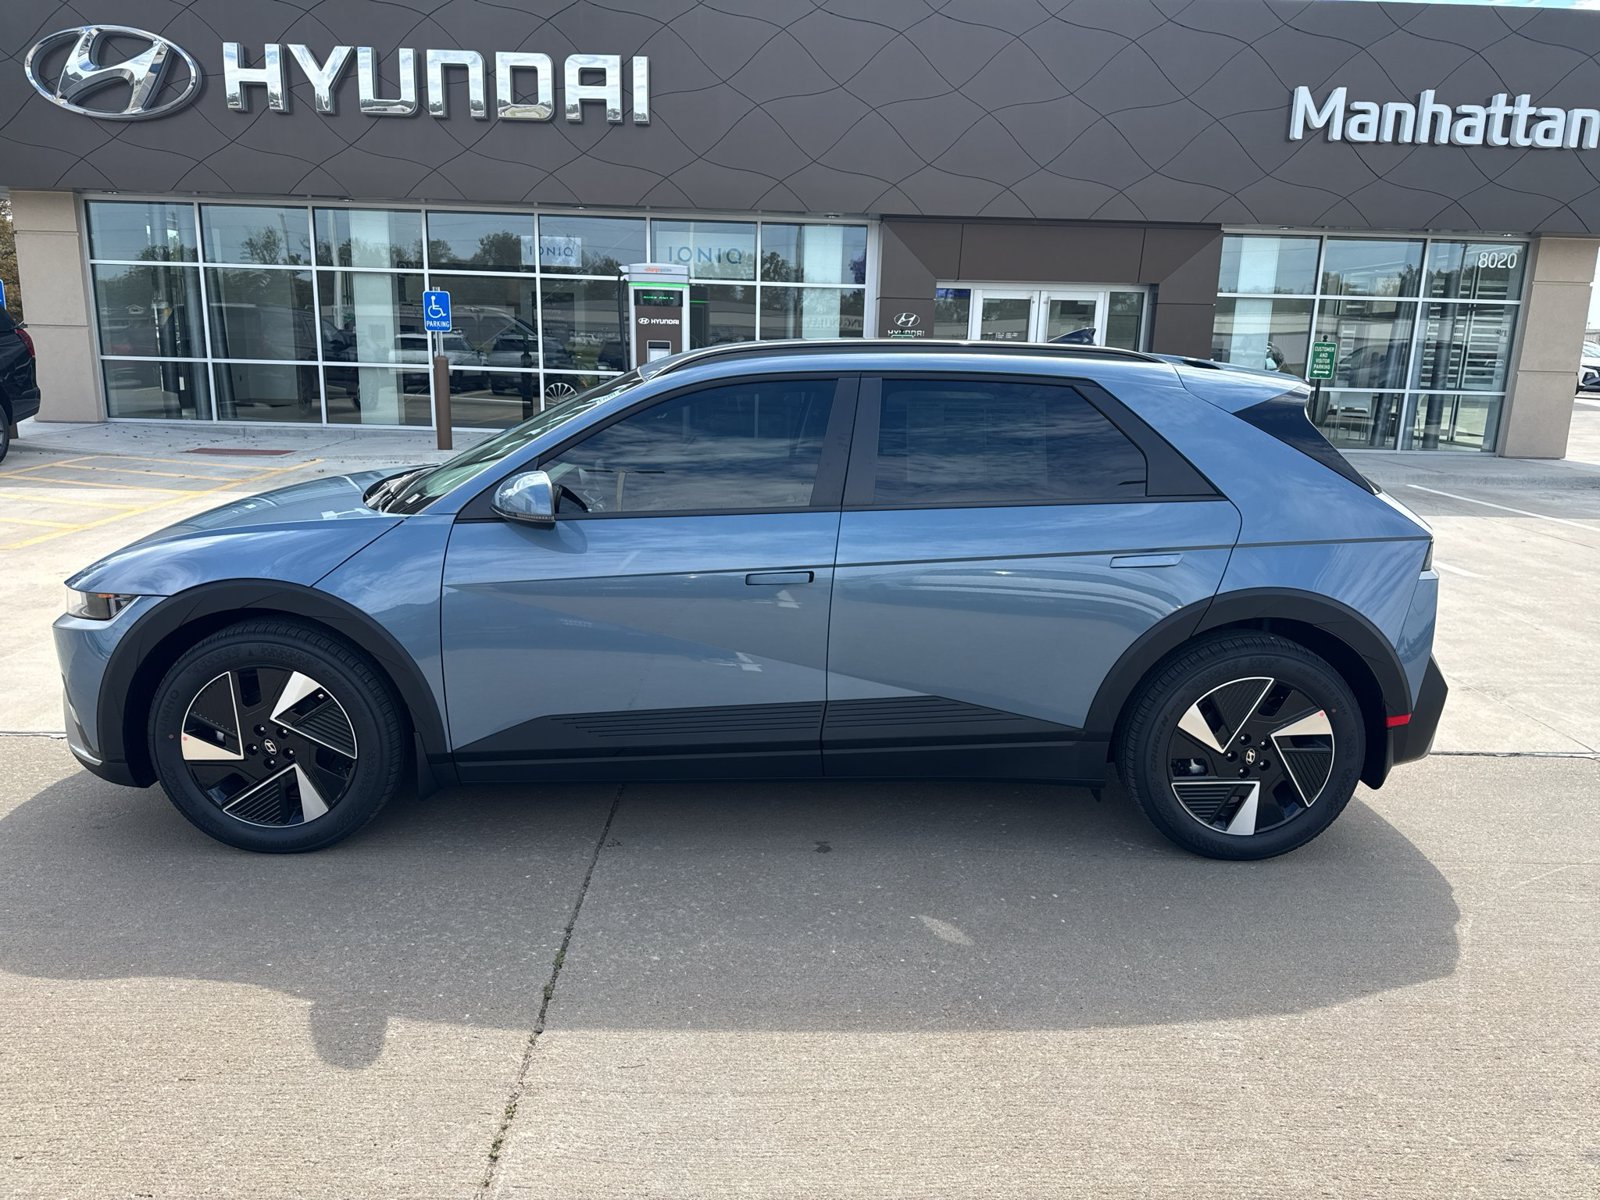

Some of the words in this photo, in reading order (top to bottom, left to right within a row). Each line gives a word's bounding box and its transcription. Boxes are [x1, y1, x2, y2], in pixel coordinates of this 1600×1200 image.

[222, 41, 651, 125] HYUNDAI
[1289, 85, 1600, 150] Manhattan
[668, 245, 743, 264] IONIQ
[1478, 252, 1518, 269] 8020
[426, 320, 450, 328] PARKING
